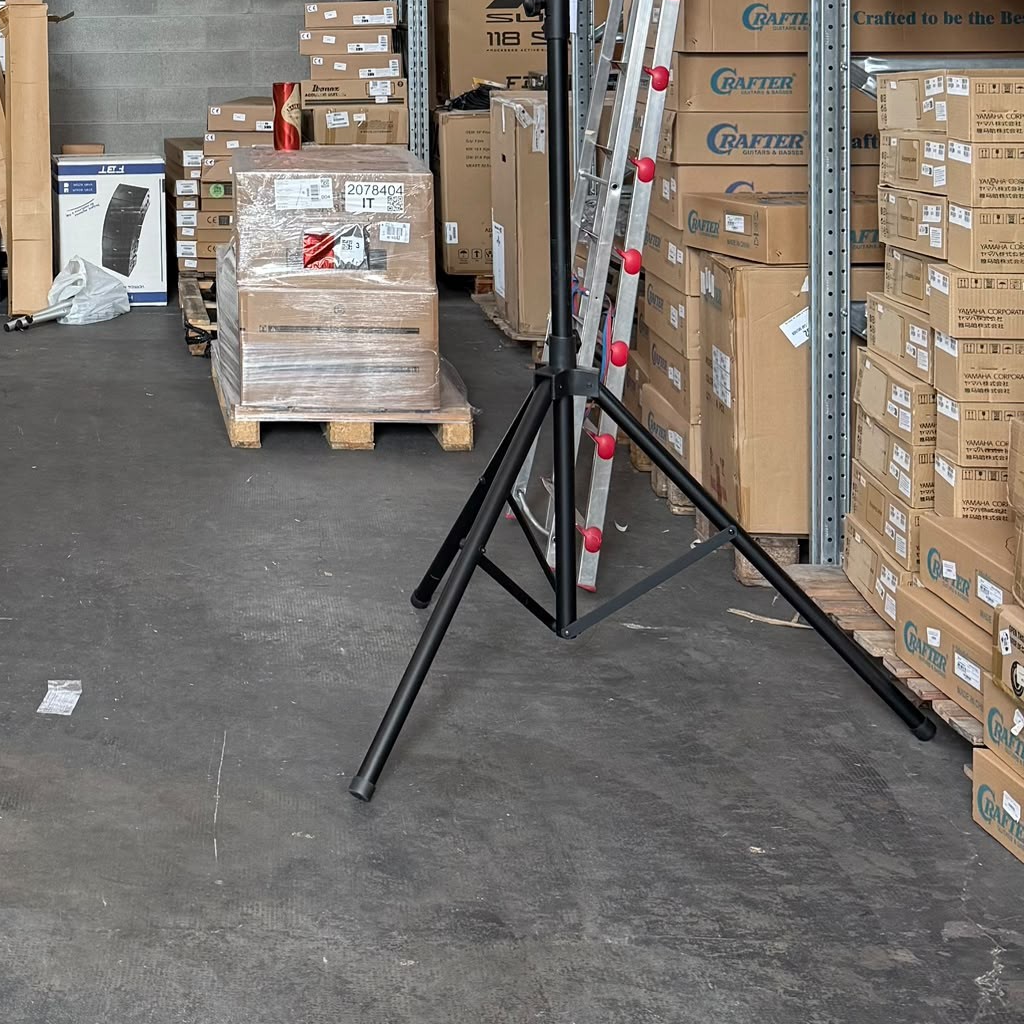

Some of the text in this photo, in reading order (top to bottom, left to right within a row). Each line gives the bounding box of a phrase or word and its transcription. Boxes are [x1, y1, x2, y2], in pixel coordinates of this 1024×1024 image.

[742, 3, 808, 31] CRAFTE
[853, 10, 917, 25] Crafted
[922, 12, 938, 25] to
[943, 11, 963, 25] be
[968, 11, 994, 25] the
[487, 31, 520, 46] 118
[710, 67, 794, 96] CRAFTER
[706, 122, 804, 156] CRAFTER
[98, 165, 125, 174] FBT
[347, 184, 403, 196] 2078404
[362, 197, 375, 209] IT
[687, 209, 720, 235] CRAFTER
[966, 439, 993, 447] YAMAHA
[903, 619, 948, 673] CRAFTER
